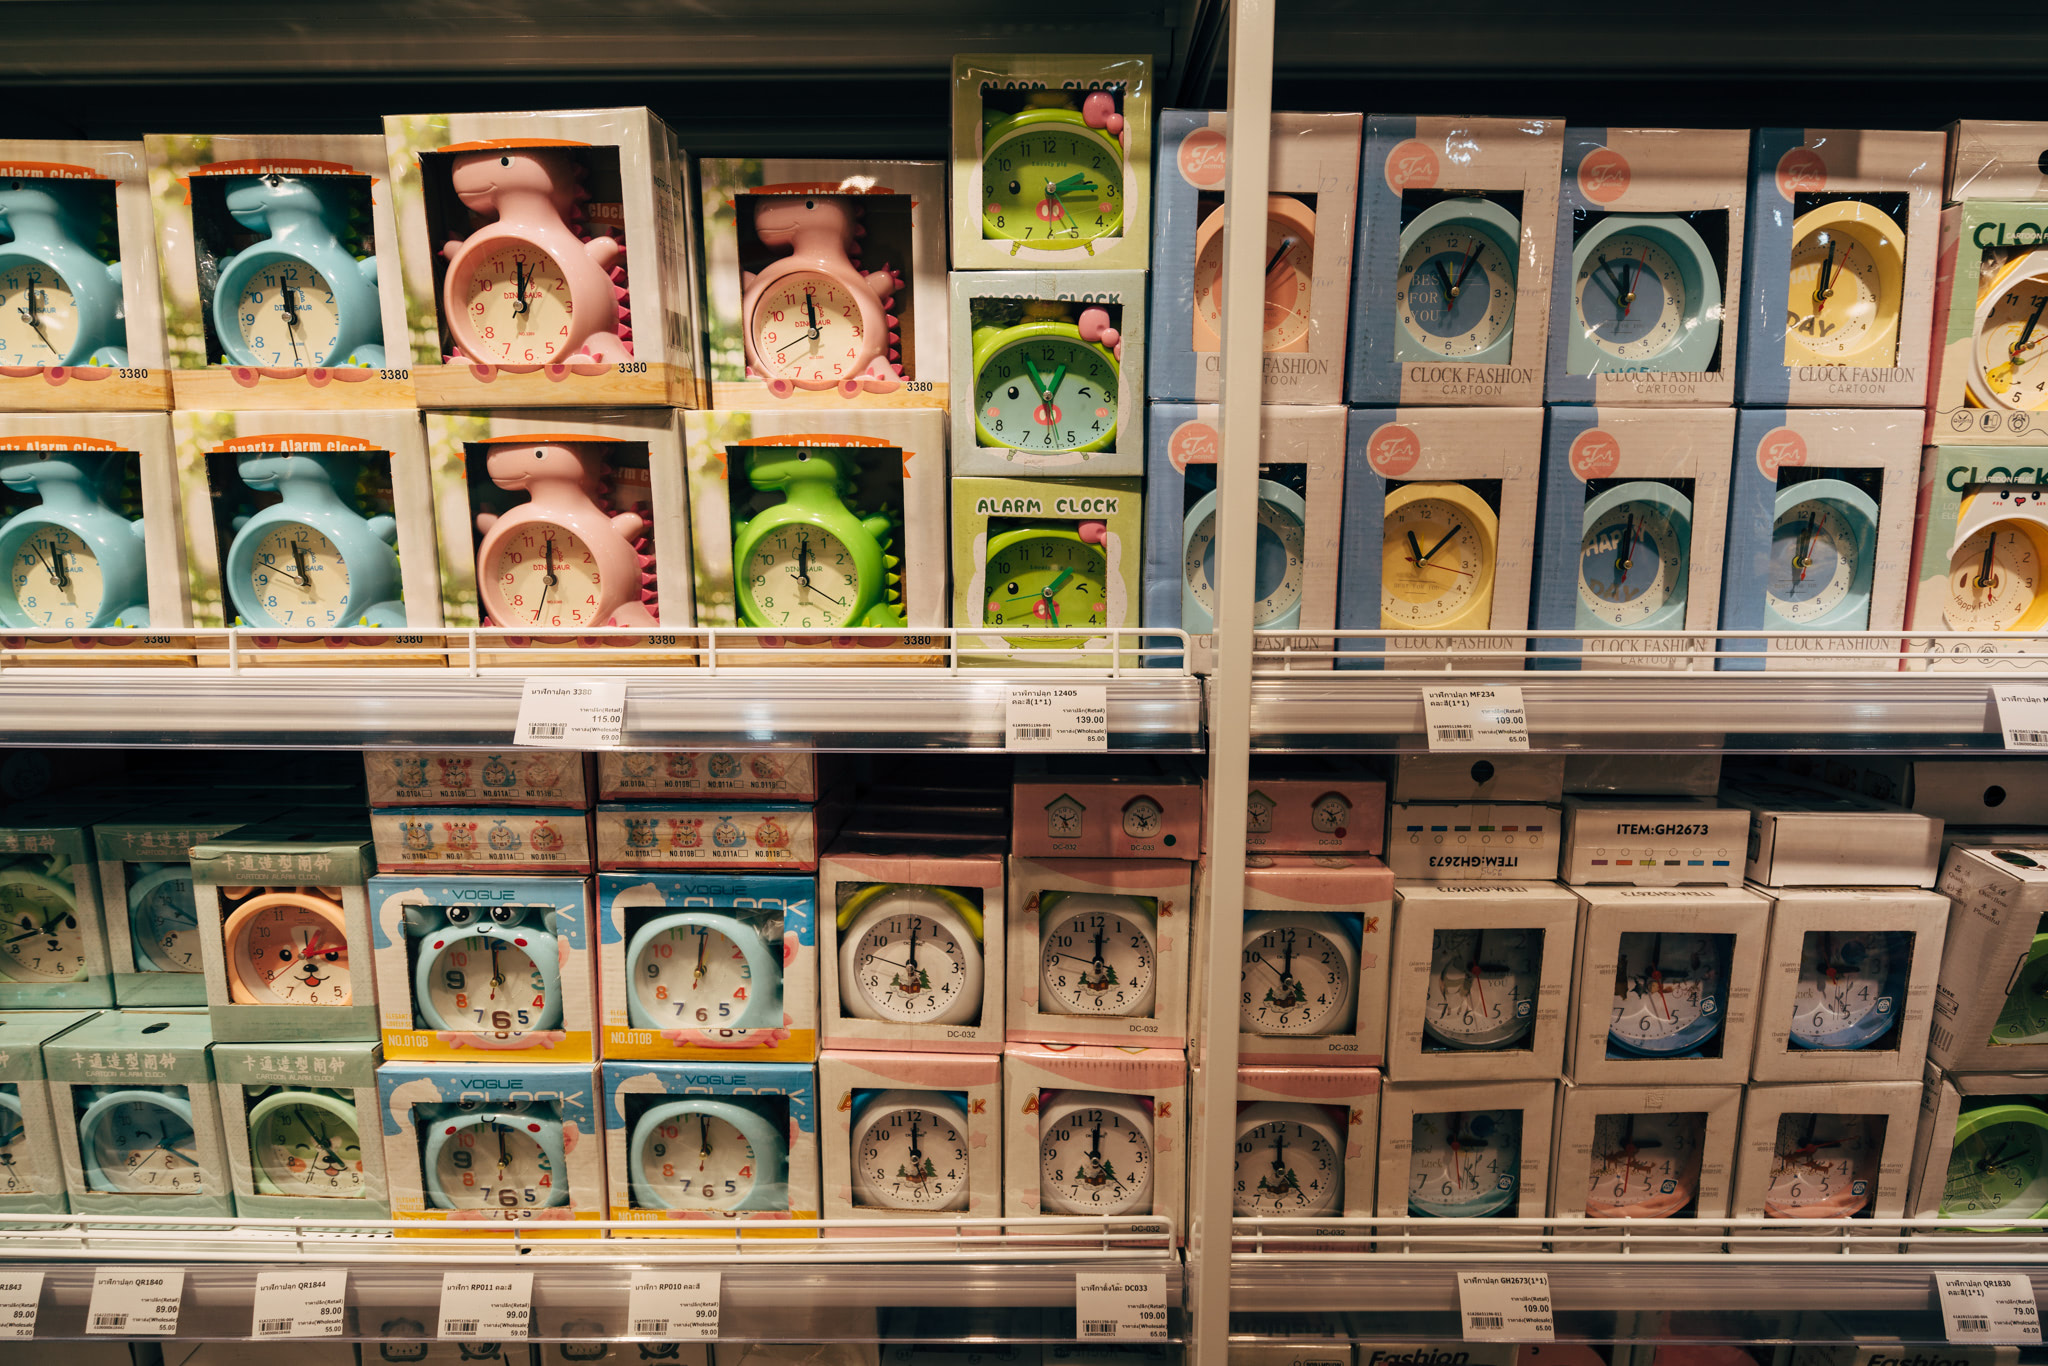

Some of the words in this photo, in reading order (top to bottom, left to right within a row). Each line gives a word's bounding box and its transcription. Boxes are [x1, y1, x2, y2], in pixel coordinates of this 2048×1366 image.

[1409, 291, 1438, 304] FOR
[1410, 310, 1440, 322] YOU
[618, 362, 647, 374] 3380
[1262, 357, 1329, 375] FASHION
[119, 369, 148, 381] 3380
[380, 369, 409, 381] 3380
[1411, 366, 1463, 383] CLOCK
[1466, 367, 1535, 384] FASHION
[1659, 367, 1726, 384] FASHION
[1798, 367, 1849, 383] CLOCK
[1852, 367, 1915, 384] FASHION
[906, 381, 933, 392] 3380
[1442, 385, 1502, 396] CARTOON
[1636, 384, 1696, 394] CARTOON
[1828, 383, 1886, 394] CARTOON
[1977, 475, 2013, 483] CARTOON
[2014, 475, 2034, 483] FRUIT
[977, 499, 1041, 513] ALARM
[1056, 499, 1118, 513] CLOCK
[533, 563, 571, 571] DINSAUR
[1953, 594, 1977, 611] Happy
[1978, 596, 1999, 610] Fruit
[143, 635, 171, 644] 3380
[395, 635, 423, 645] 3380
[648, 635, 676, 645] 3380
[903, 635, 931, 645] 3380
[1394, 637, 1445, 649] CLOCK
[1776, 638, 1826, 651] CLOCK
[1828, 638, 1890, 651] FASHION
[1591, 639, 1642, 652] CLOCK
[573, 688, 593, 696] 3380
[1429, 691, 1468, 699] นาฬิกาปลุก
[592, 715, 621, 723] 115.00
[1075, 715, 1104, 724] 139.00
[1495, 716, 1524, 724] 109.00
[1617, 823, 1709, 836] ITEM:GH2673
[1052, 843, 1077, 851] DC-032
[221, 854, 332, 872] 卡通造型闹钟
[1428, 855, 1518, 868] ITEM:GH2673
[235, 872, 269, 881] CARTOON
[271, 872, 296, 881] ALARM
[298, 873, 321, 882] CLOCK
[684, 884, 748, 895] VOGUE
[452, 889, 516, 901] VOGUE
[947, 1030, 976, 1038] DC-032
[1129, 1025, 1159, 1033] DC-032
[387, 1034, 429, 1048] NO.010B
[611, 1031, 653, 1045] NO.010B
[1328, 1043, 1359, 1052] DC-032
[71, 1052, 176, 1072] 卡通造型闹钟
[242, 1055, 346, 1074] 卡通造型闹钟
[85, 1069, 117, 1078] CARTOON
[119, 1070, 143, 1079] ALARM
[144, 1071, 167, 1079] CLOCK
[460, 1079, 524, 1089] VOGUE
[685, 1075, 747, 1086] VOGUE
[1131, 1224, 1160, 1233] DC-032
[1316, 1228, 1346, 1237] DC-032
[135, 1278, 164, 1287] QR1840
[298, 1281, 327, 1290] QR1844
[470, 1283, 494, 1291] RP011
[659, 1283, 682, 1291] RP010
[1983, 1280, 2012, 1288] QR1830
[1124, 1284, 1148, 1292] DC033
[155, 1305, 178, 1314] 89.00
[320, 1306, 342, 1316] 89.00
[695, 1309, 718, 1318] 99.00
[1523, 1304, 1550, 1313] 109.00
[2013, 1307, 2036, 1316] 79.00
[13, 1310, 35, 1319] 89.00
[506, 1310, 529, 1319] 99.00
[1139, 1311, 1166, 1320] 109.00
[1369, 1348, 1470, 1366] Fashion
